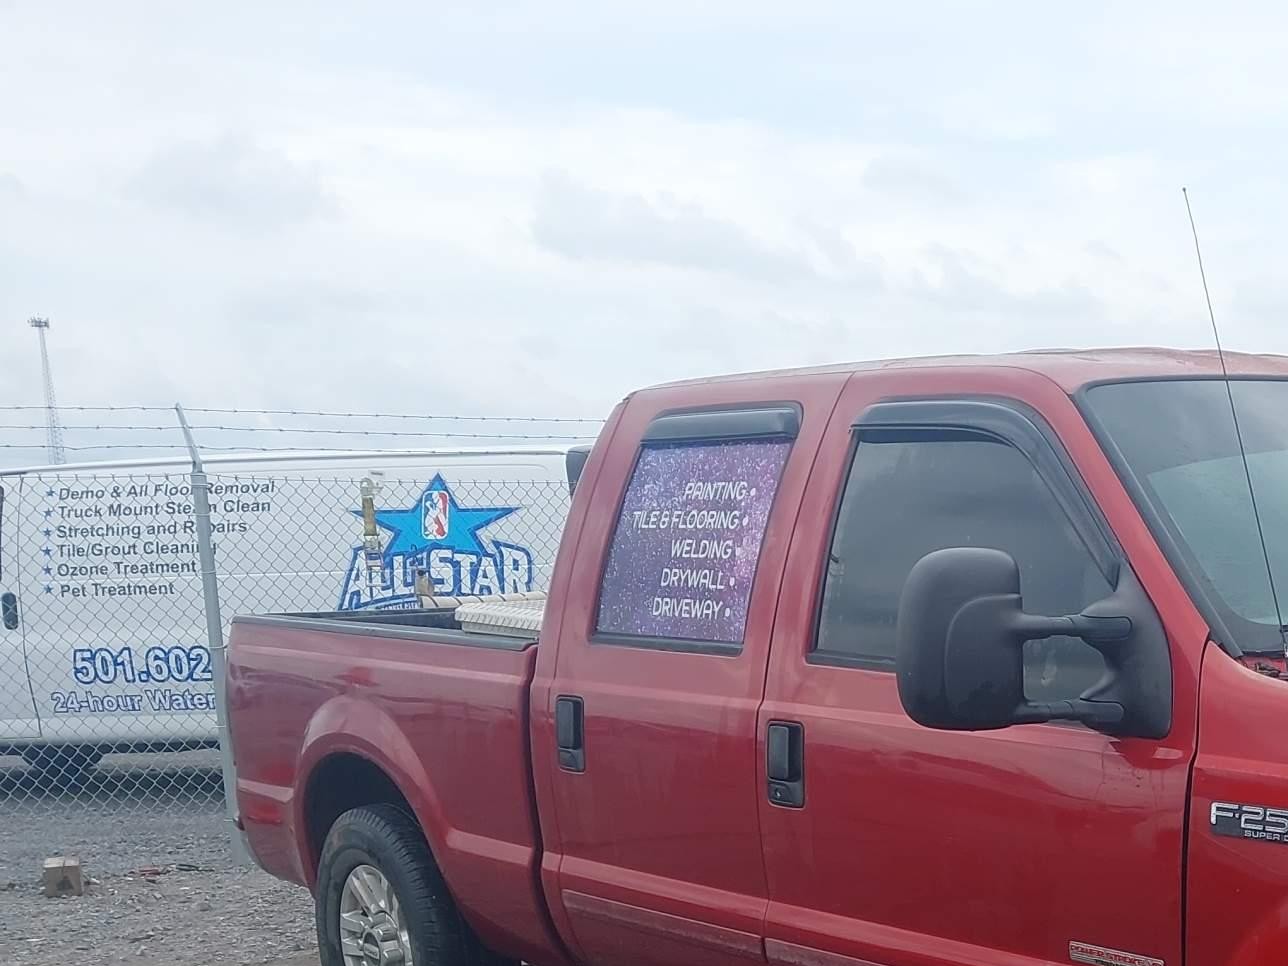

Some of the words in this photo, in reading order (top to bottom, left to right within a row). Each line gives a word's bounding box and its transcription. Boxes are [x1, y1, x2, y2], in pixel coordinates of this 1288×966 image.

[59, 488, 104, 501] Demo
[110, 486, 121, 498] &
[126, 484, 148, 498] All
[154, 484, 193, 497] Floo
[684, 481, 748, 500] PAINTING
[58, 505, 103, 519] Truck
[108, 503, 160, 517] Mount
[223, 500, 271, 513] Clean
[57, 523, 141, 539] Stretching
[146, 521, 177, 535] and
[183, 519, 248, 537] Rpairs
[632, 511, 658, 529] TILE
[671, 510, 740, 530] FLOORING
[57, 543, 138, 558] Tile/Grout
[143, 540, 217, 556] Cleani
[671, 539, 732, 559] WELDING
[57, 563, 108, 577] Ozone
[115, 560, 197, 575] Treatment
[660, 568, 725, 590] DRYWALL
[60, 584, 87, 598] Pet
[92, 581, 175, 597] Treatment
[652, 597, 723, 619] DRIVEWAY
[73, 645, 213, 685] 501.602
[51, 690, 142, 713] 24-hour
[145, 688, 216, 711] Water
[1244, 829, 1281, 841] SUPER
